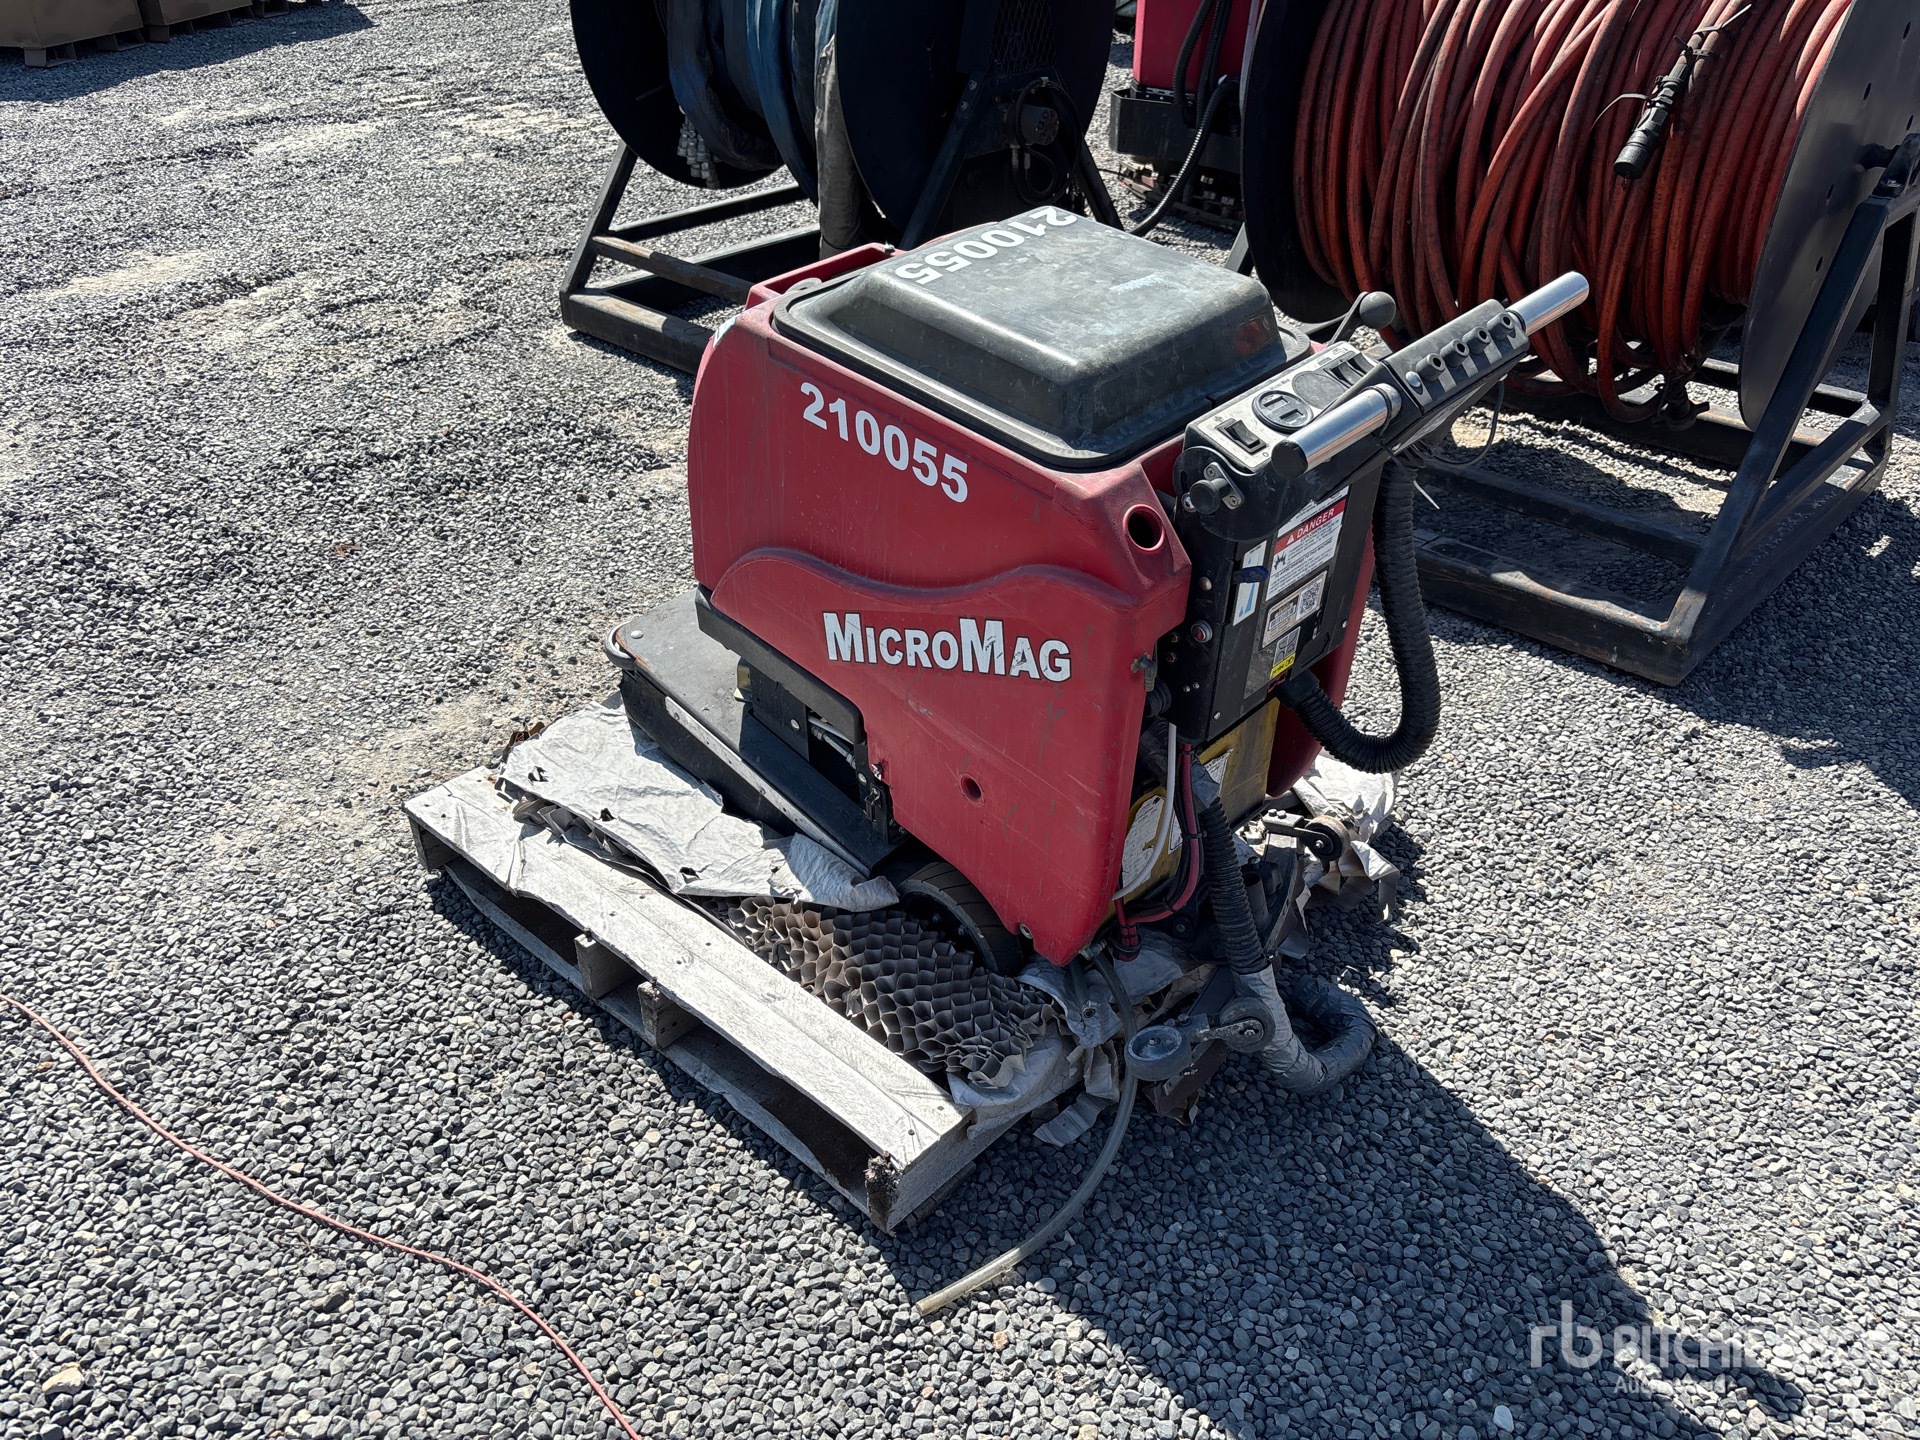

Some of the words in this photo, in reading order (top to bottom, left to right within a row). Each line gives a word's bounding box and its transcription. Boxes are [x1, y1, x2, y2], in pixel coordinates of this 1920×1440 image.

[895, 207, 1077, 285] 210055
[800, 382, 968, 503] 210055
[1296, 508, 1335, 539] DANGER
